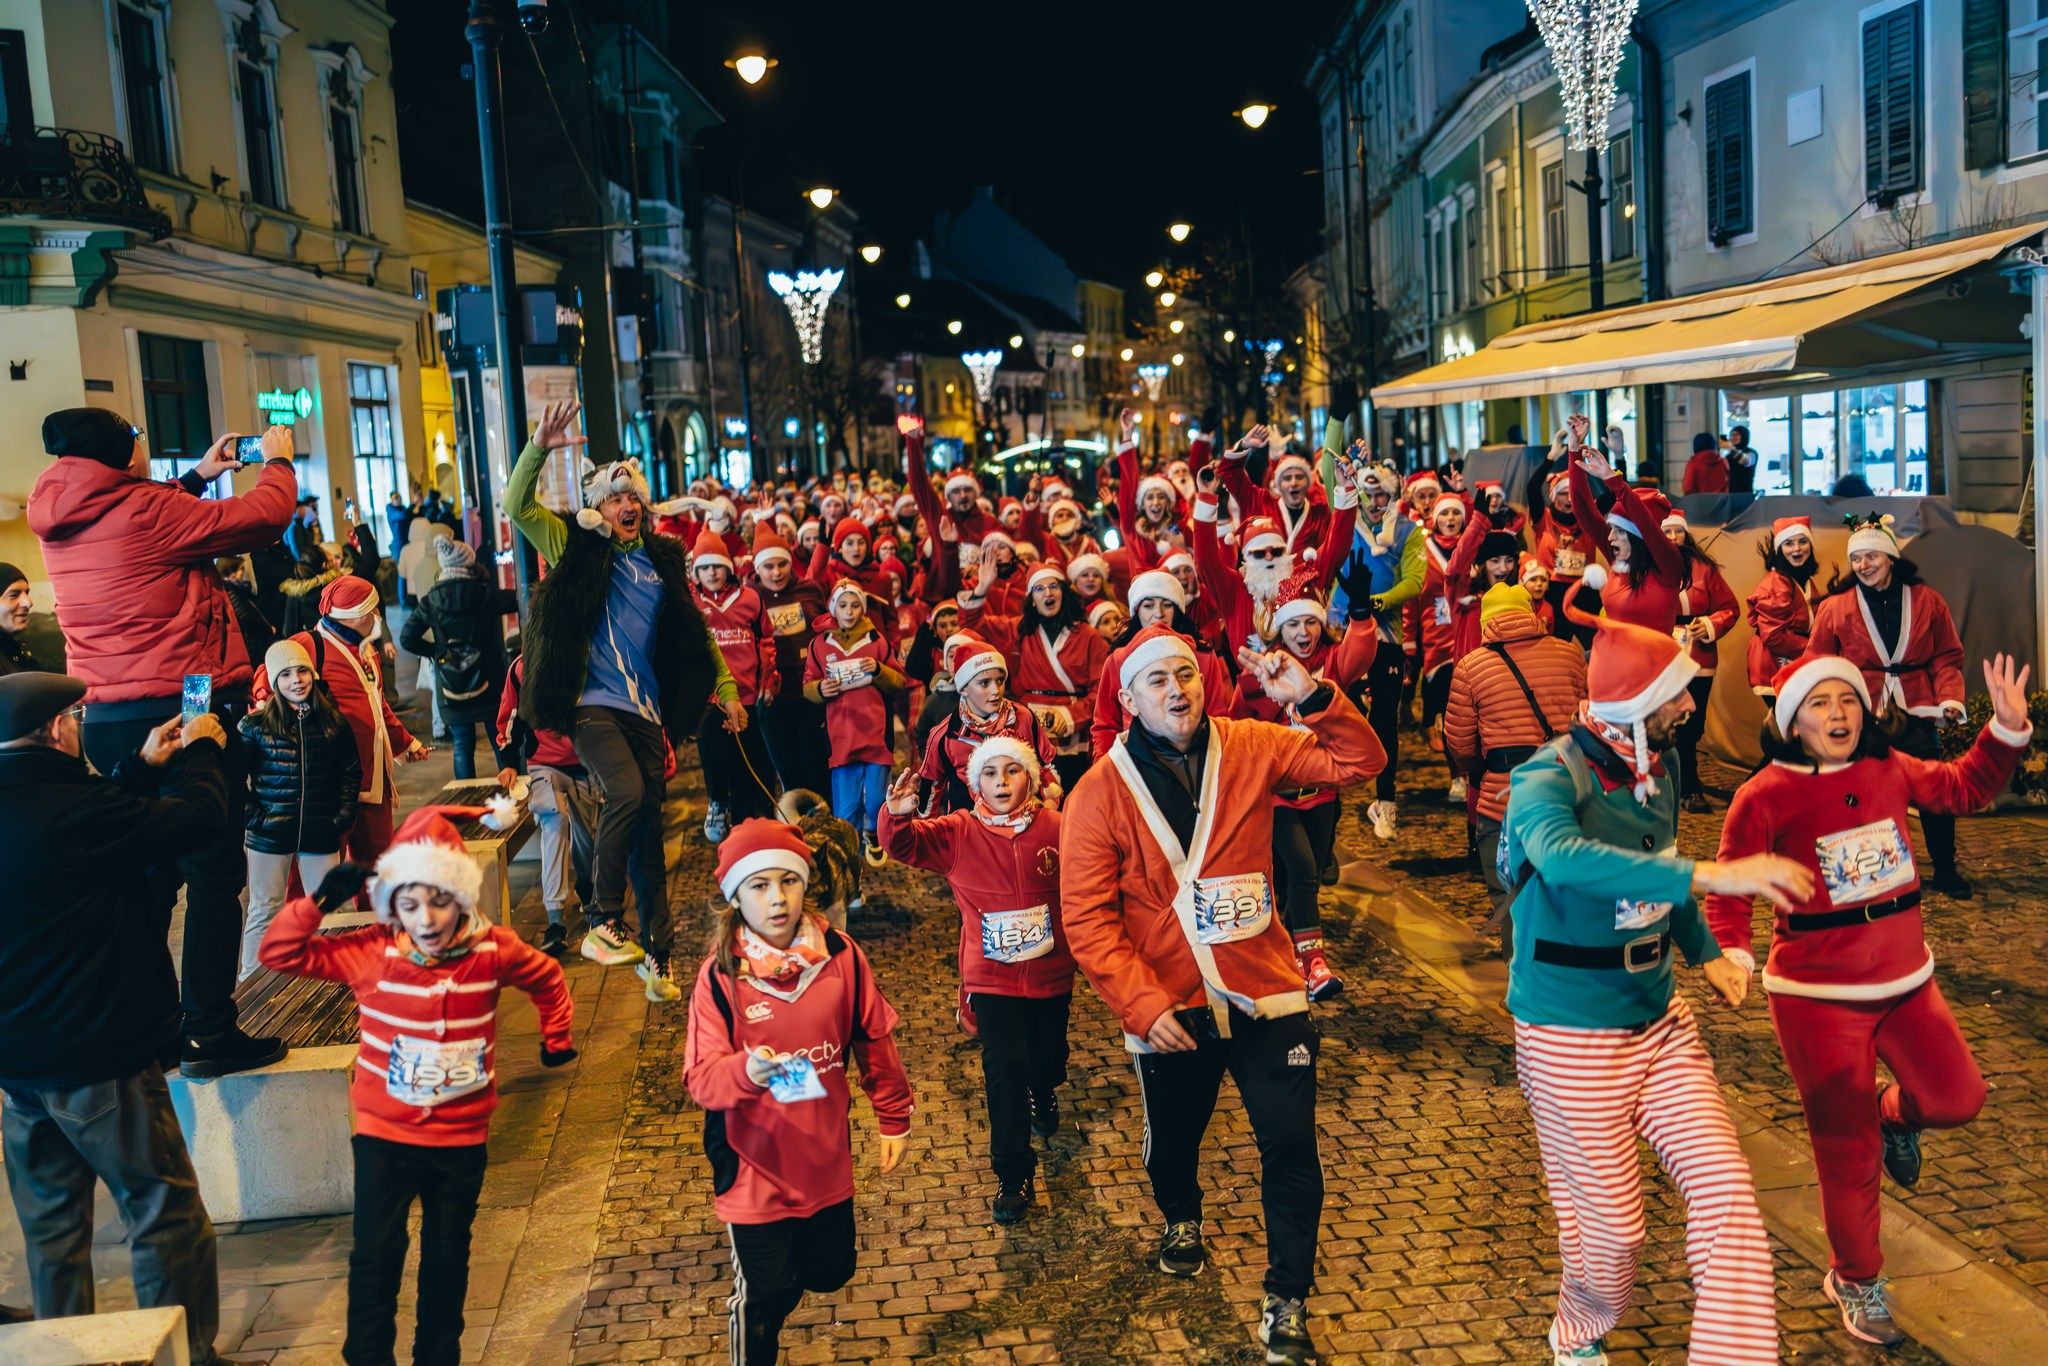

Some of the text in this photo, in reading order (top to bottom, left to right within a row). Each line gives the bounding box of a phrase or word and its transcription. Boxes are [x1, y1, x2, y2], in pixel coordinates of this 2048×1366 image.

[1855, 849, 1883, 877] 2
[1212, 896, 1258, 923] 39
[989, 924, 1045, 949] 184
[401, 1060, 477, 1087] 199
